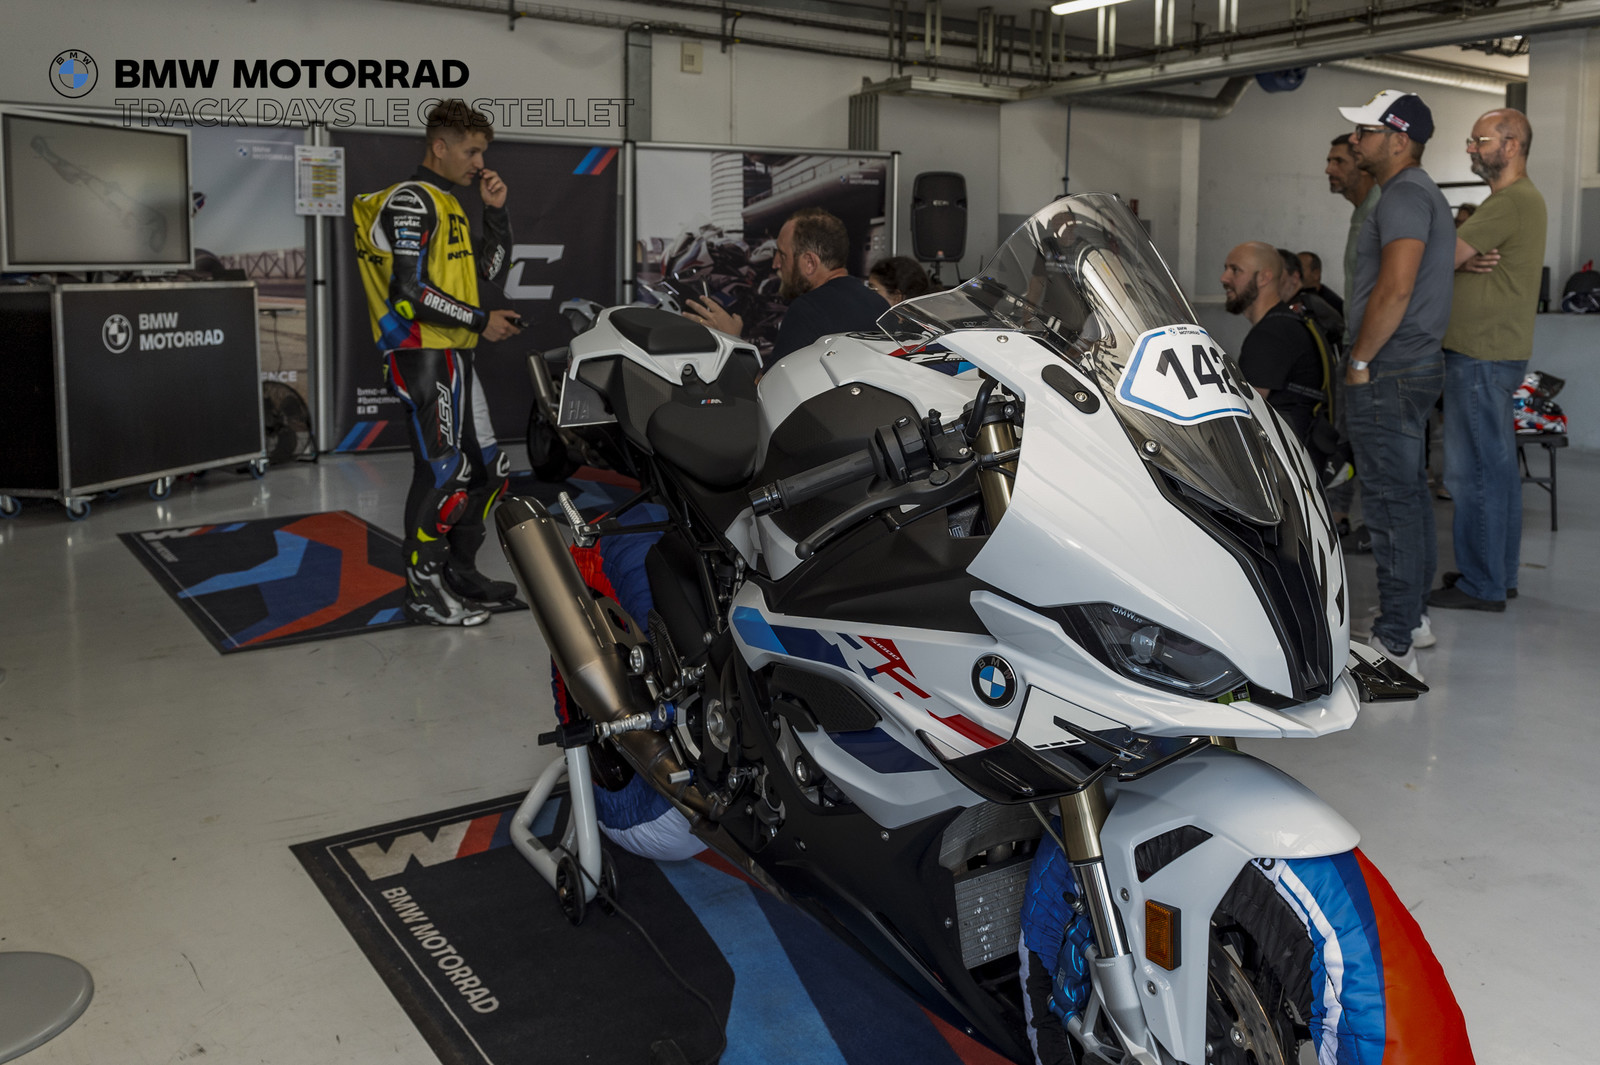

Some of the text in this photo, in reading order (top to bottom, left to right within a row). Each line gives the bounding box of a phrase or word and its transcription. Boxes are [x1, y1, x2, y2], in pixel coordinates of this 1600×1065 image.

[138, 311, 179, 331] BMW
[139, 328, 225, 351] MOTORRAD
[436, 381, 454, 447] RST
[1112, 606, 1135, 620] BMW
[977, 657, 1013, 681] BMW
[381, 886, 500, 1014] BMW MOTORRAD
